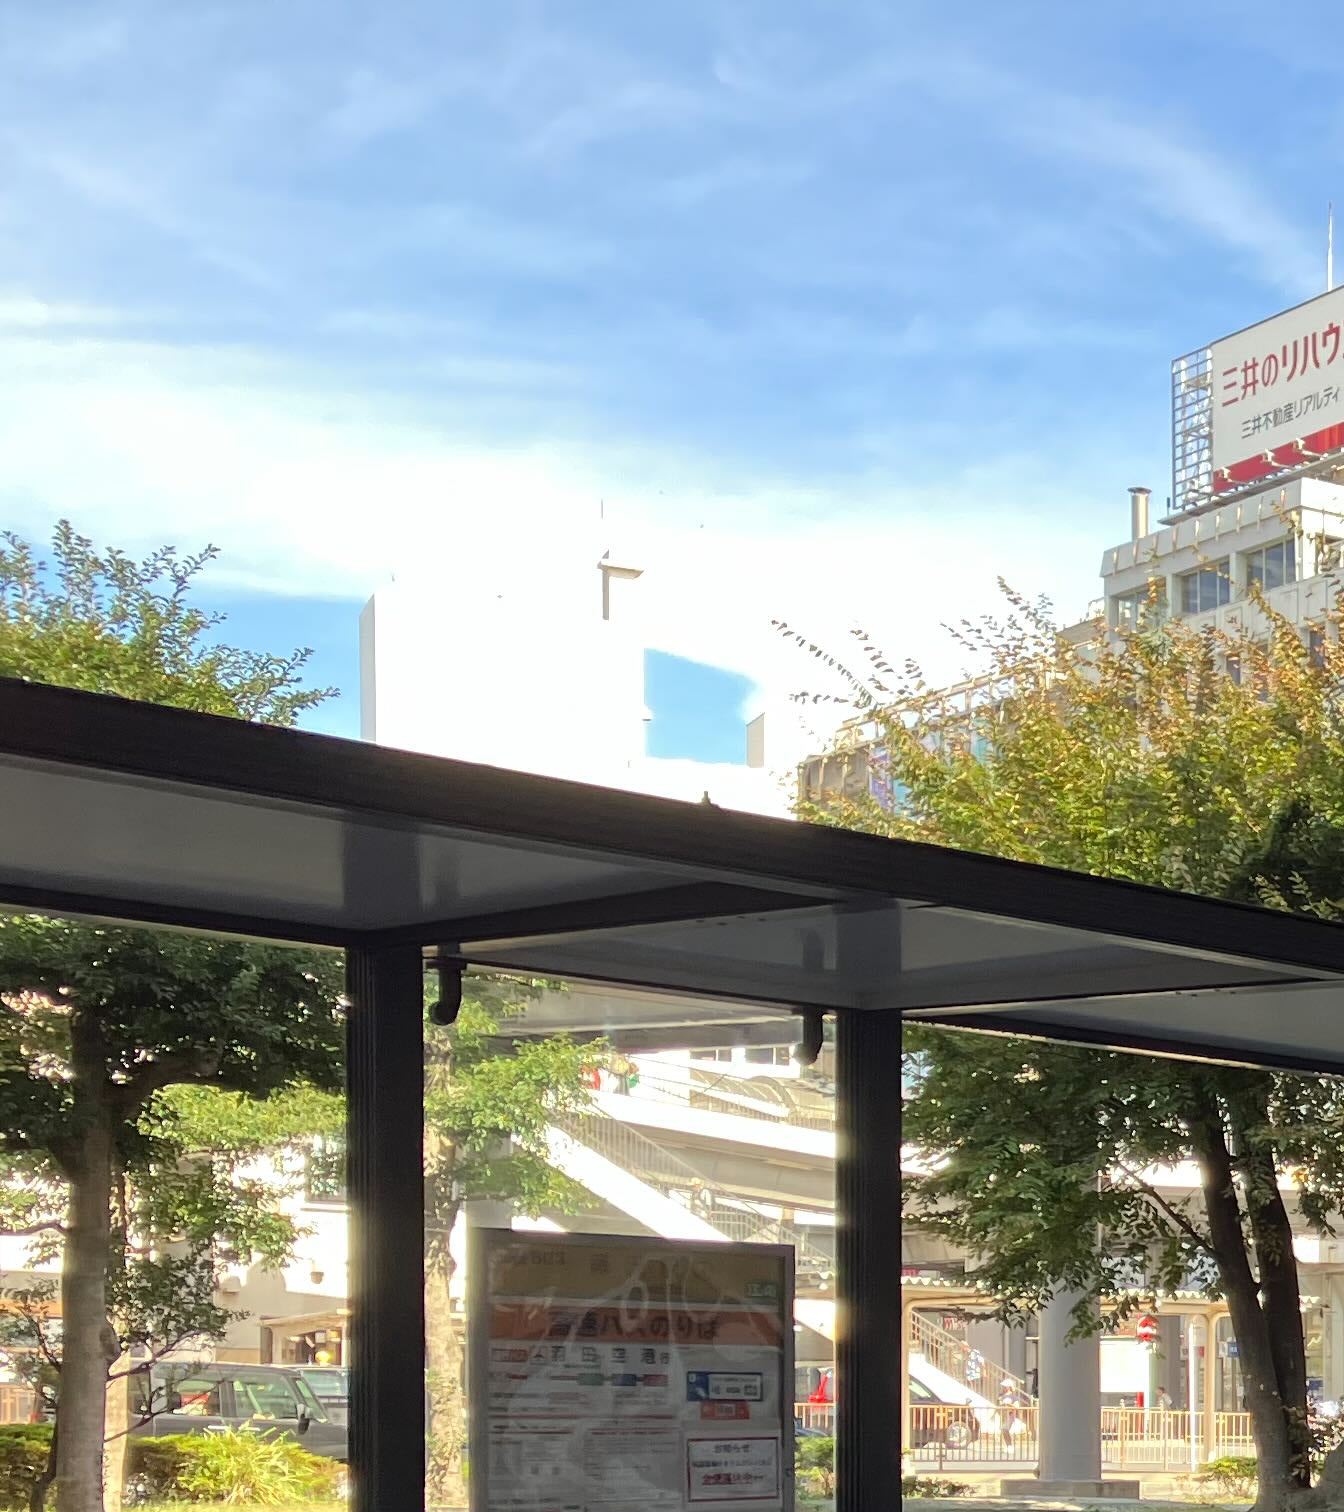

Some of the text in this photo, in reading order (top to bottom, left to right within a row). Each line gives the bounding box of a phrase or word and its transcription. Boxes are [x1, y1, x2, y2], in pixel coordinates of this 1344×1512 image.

[1241, 386, 1341, 440] 三井不動産リアルティ
